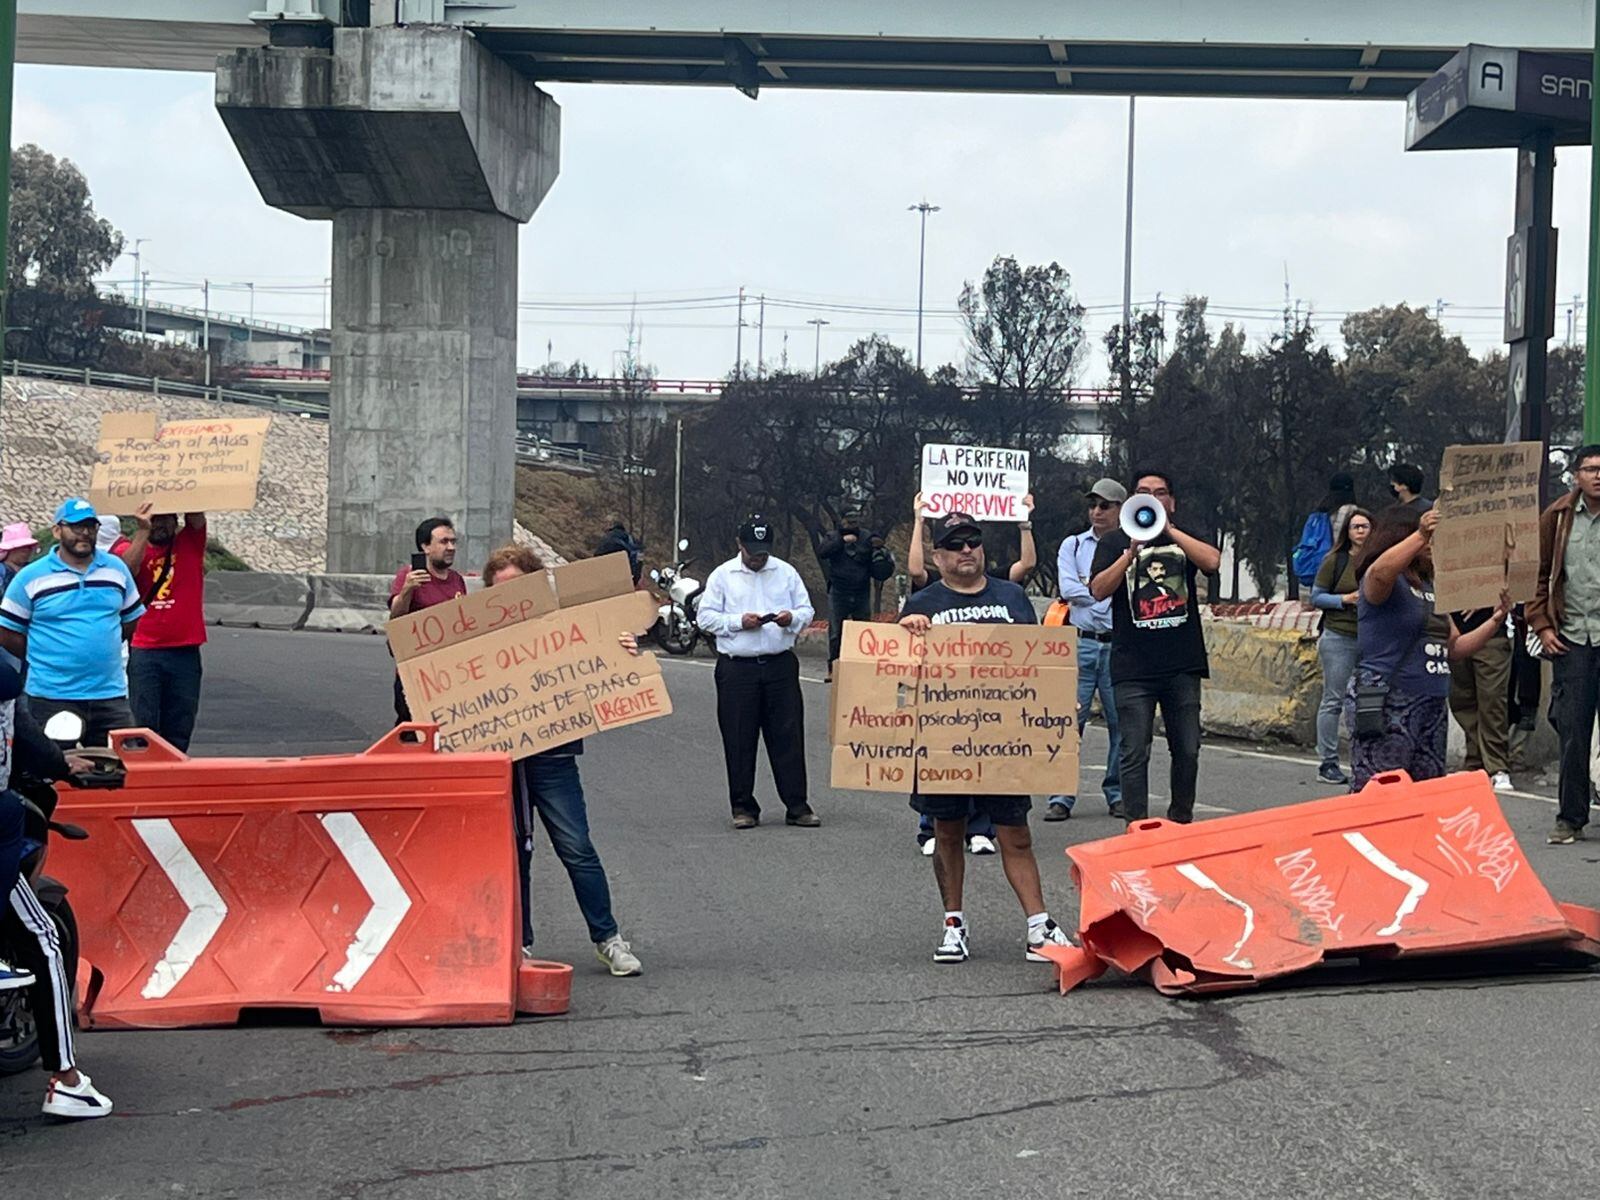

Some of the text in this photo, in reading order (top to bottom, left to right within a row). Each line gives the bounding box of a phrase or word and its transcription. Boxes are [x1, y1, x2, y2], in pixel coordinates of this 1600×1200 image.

[1481, 61, 1504, 92] A
[186, 435, 202, 448] al
[115, 451, 130, 462] de
[178, 452, 186, 467] y
[928, 447, 1027, 472] LA PERIFERIA
[176, 468, 197, 477] con
[947, 469, 968, 486] NO
[108, 479, 198, 498] PELIGROSO
[927, 492, 1017, 517] SOBREVIVE
[412, 594, 533, 651] 10 de Sep
[932, 605, 1014, 625] ANTISOCIAL
[859, 629, 899, 656] Que
[1023, 639, 1038, 666] y
[1042, 640, 1071, 657] sus
[456, 654, 486, 684] SE
[970, 661, 1038, 679] reciban
[430, 682, 519, 728] EXIGIMOS
[553, 688, 579, 712] DE
[594, 688, 658, 723] URGENTE
[520, 731, 534, 748] A
[537, 710, 593, 739] GASERAS
[1020, 706, 1073, 740] trabajo
[952, 736, 1032, 757] educación
[1046, 744, 1061, 763] y
[880, 766, 904, 782] NO
